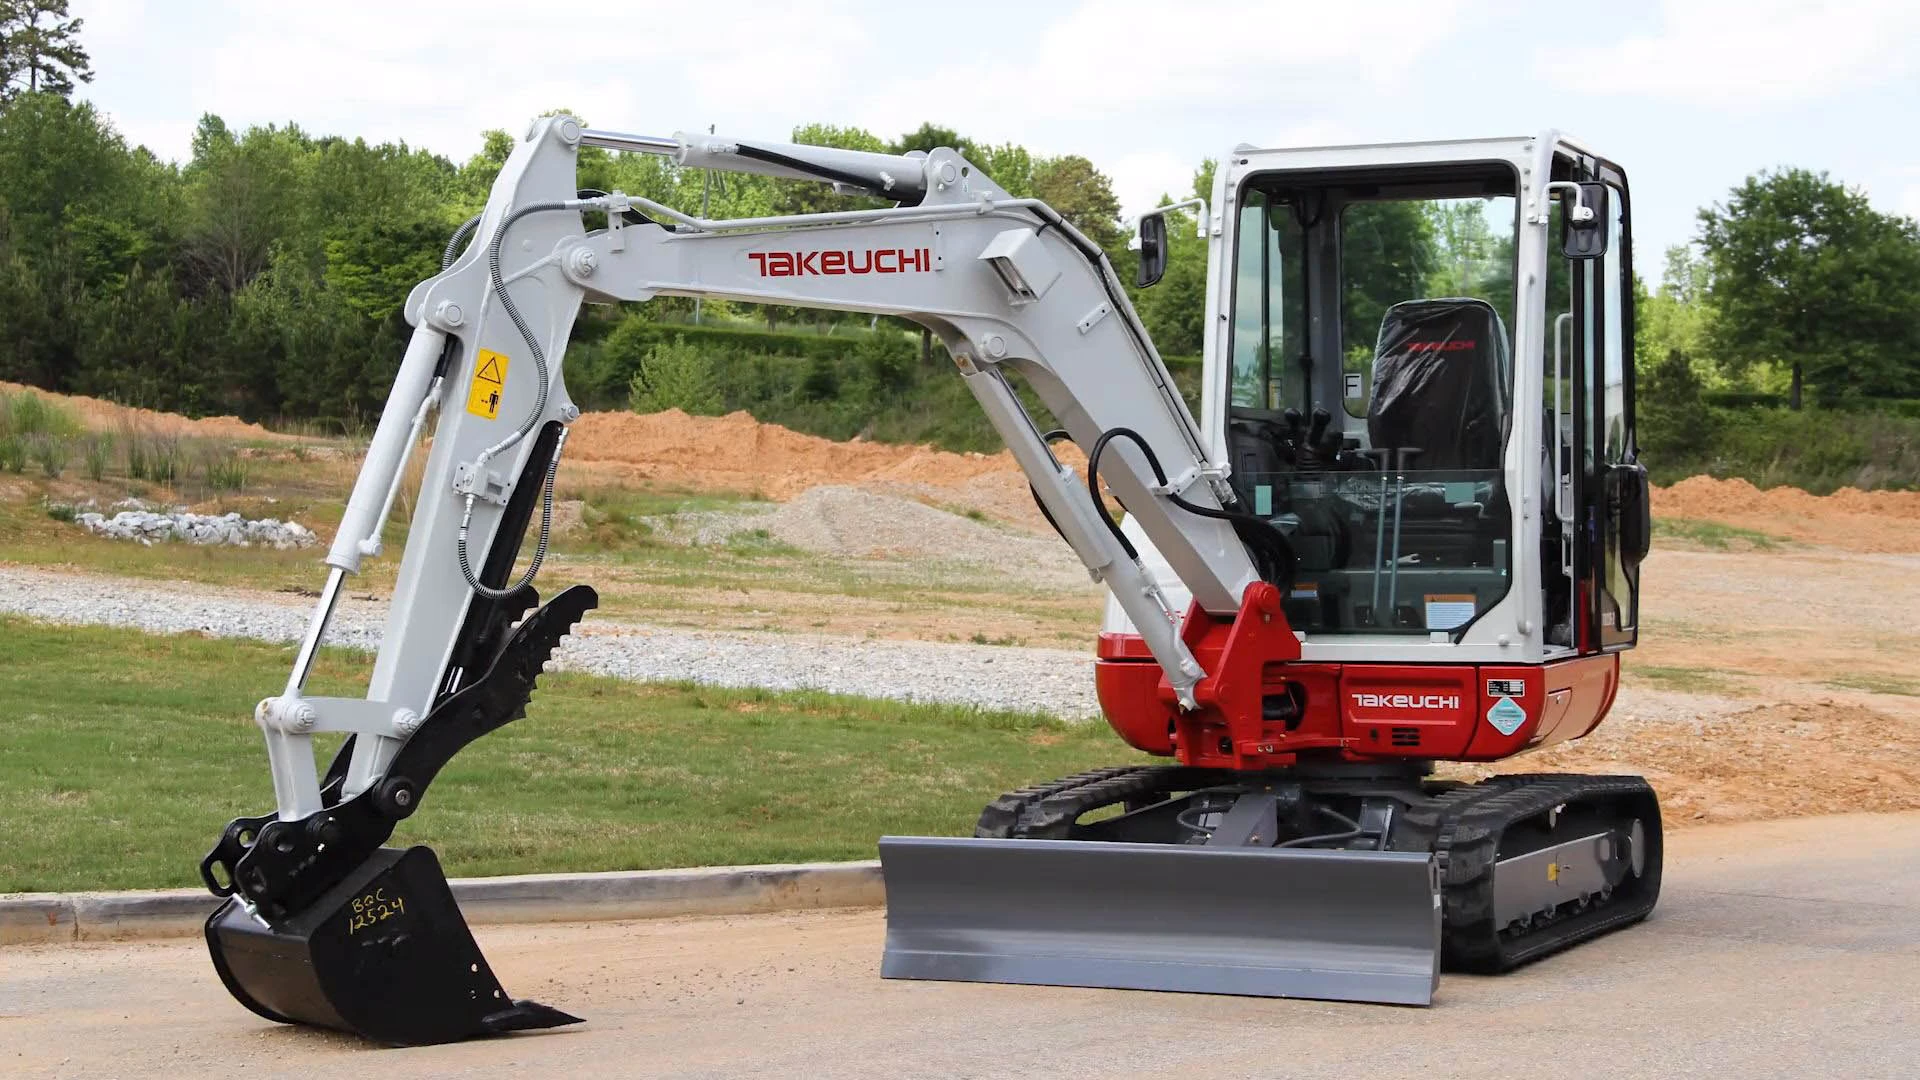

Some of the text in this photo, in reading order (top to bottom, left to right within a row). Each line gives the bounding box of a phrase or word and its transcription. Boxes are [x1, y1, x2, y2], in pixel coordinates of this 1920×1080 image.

[748, 248, 931, 277] TAKEUCHI
[1345, 375, 1360, 397] F
[1351, 693, 1460, 709] TAKEUCHI
[349, 897, 405, 935] 12524
